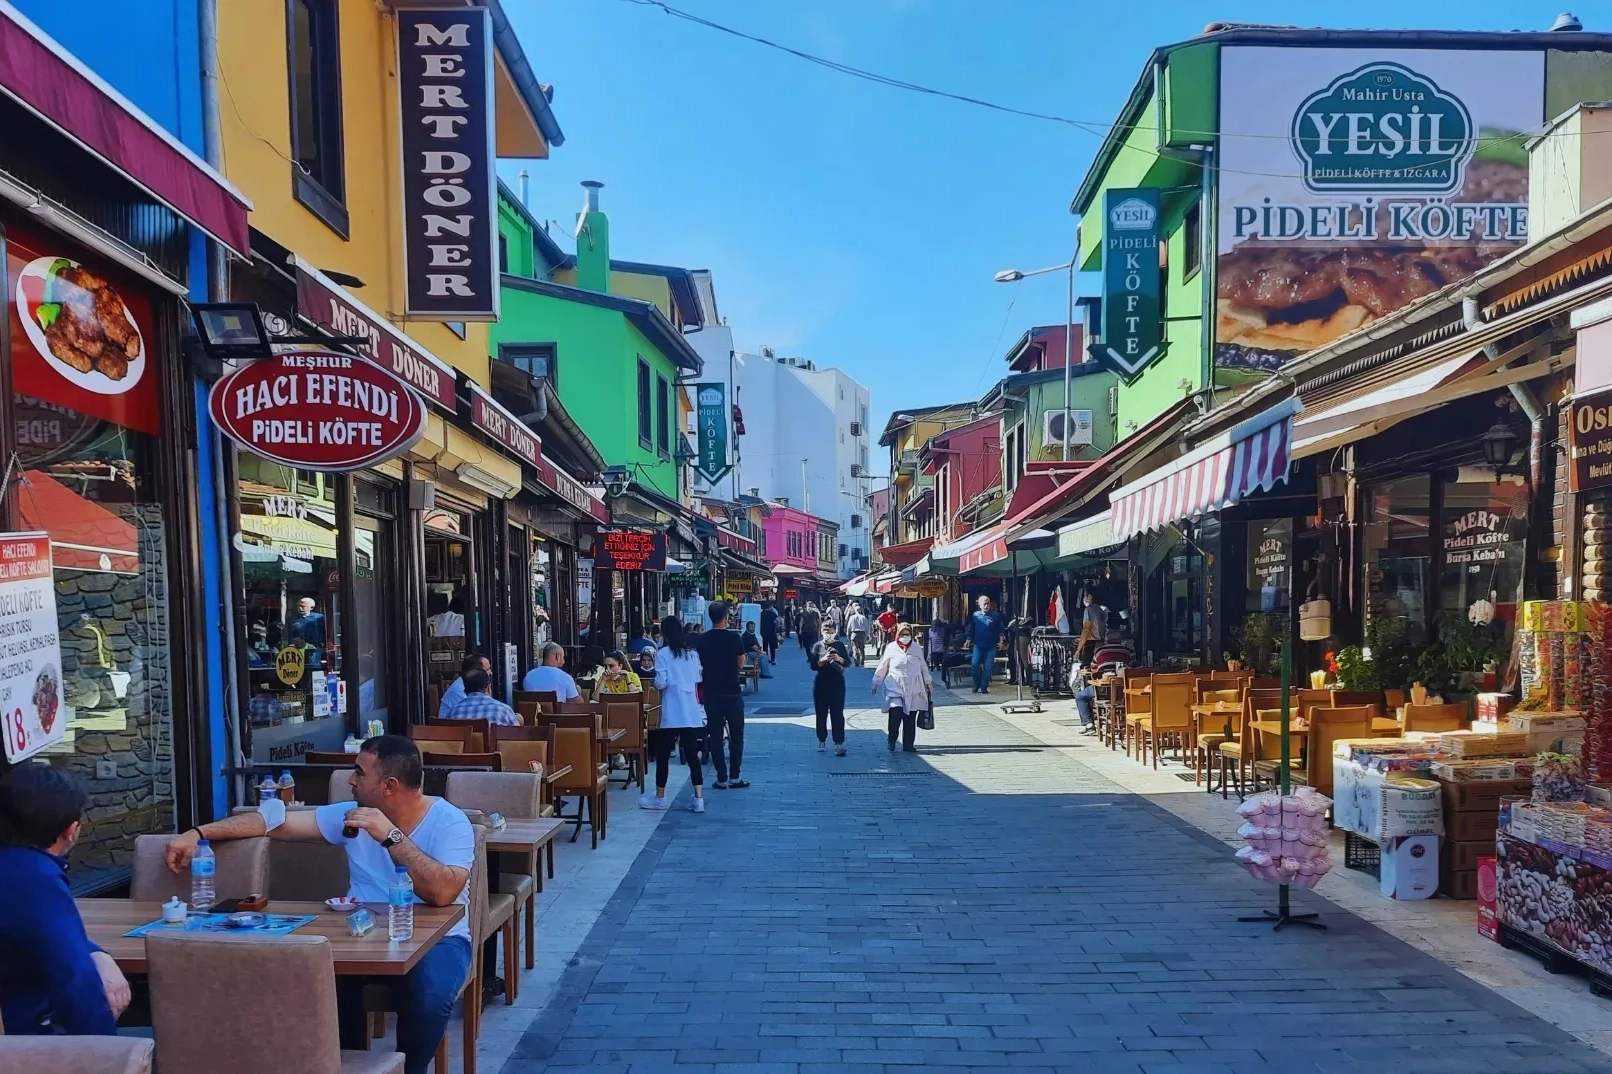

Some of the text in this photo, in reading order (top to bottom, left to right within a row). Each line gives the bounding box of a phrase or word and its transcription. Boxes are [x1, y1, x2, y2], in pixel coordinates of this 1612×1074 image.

[1342, 88, 1425, 101] Mahir Usta
[1306, 104, 1458, 159] YEŞİL
[414, 24, 476, 296] MERT DÖNER
[1315, 166, 1448, 178] PİDELİ KÖFTE & IZGARA
[1232, 196, 1528, 238] PİDELİ KÖFTE
[1110, 234, 1158, 249] PİDELİ
[1125, 252, 1141, 354] KÖFTE
[330, 298, 440, 398] MERT DÖNER
[282, 355, 352, 370] MEŞHUR
[236, 374, 399, 424] HACI EFENDİ
[698, 408, 724, 416] PİDELİ
[319, 417, 382, 446] KÖFTE
[481, 402, 536, 462] MERT DÖNER
[707, 418, 716, 472] KÖFTE
[1588, 446, 1596, 455] ve
[556, 474, 574, 499] BURSA
[262, 496, 308, 520] MERT
[1454, 511, 1499, 536] MERT
[1259, 538, 1282, 556] MERT
[1444, 532, 1510, 548] Pideli Köfte
[2, 544, 16, 559] HACI
[1446, 553, 1471, 563] Bursa
[9, 559, 27, 577] KÖFTE
[18, 586, 43, 613] KÖFTE
[278, 651, 302, 670] MERT
[283, 668, 298, 679] Döner
[6, 708, 26, 756] 18
[269, 744, 292, 762] Pideli
